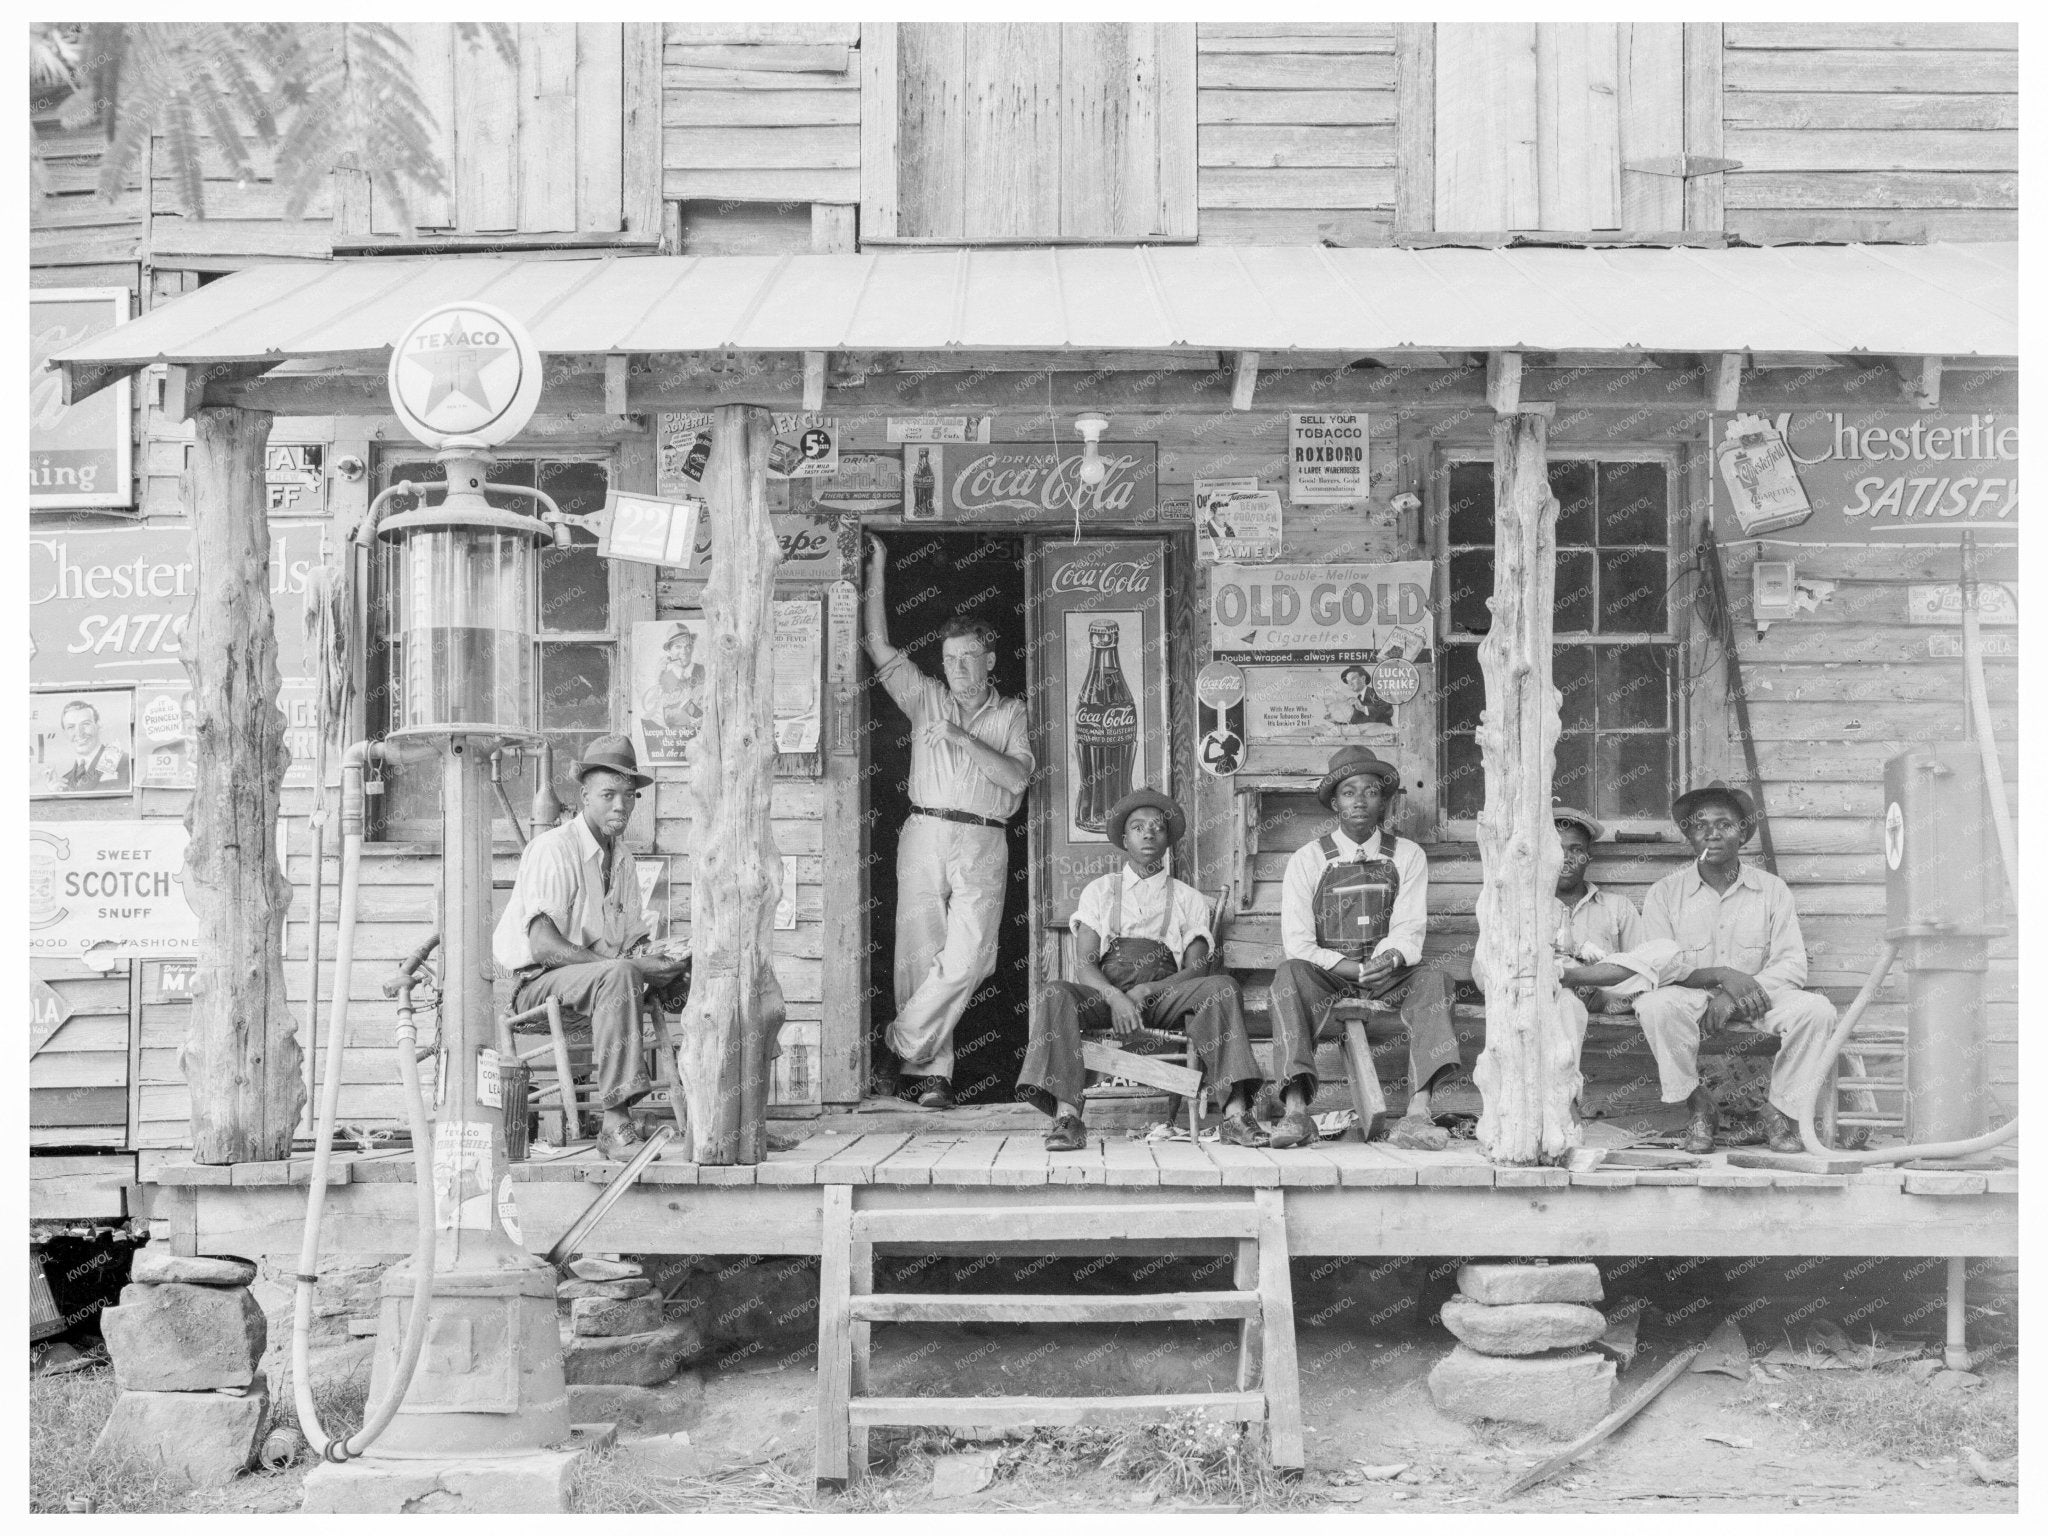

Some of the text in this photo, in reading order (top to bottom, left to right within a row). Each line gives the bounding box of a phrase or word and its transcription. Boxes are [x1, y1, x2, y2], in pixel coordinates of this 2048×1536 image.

[416, 331, 500, 350] TEXACO
[1300, 415, 1358, 424] SELL YOUR
[1296, 428, 1362, 439] TOBACCO
[1001, 455, 1056, 465] DRINK
[1295, 446, 1363, 462] ROXBORO
[1739, 442, 1786, 485] Chesterfield
[1298, 466, 1361, 475] 4 LARGE WAREHOUSES
[951, 454, 1144, 511] Coca-Cola
[1304, 485, 1357, 493] Accommodations
[618, 503, 670, 546] 22
[1051, 560, 1154, 593] Coca-Cola
[1274, 569, 1370, 582] Double-Mellow
[1216, 582, 1429, 627] OLD GOLD
[1266, 630, 1349, 647] Cigarettes
[1221, 653, 1252, 663] Double
[1303, 652, 1336, 664] always
[1379, 667, 1413, 679] LUCKY
[1198, 675, 1242, 691] Coca-Cola
[1377, 679, 1416, 691] STRIKE
[145, 714, 180, 726] PRINCELY
[1075, 705, 1136, 728] Coca-Cola
[664, 727, 677, 736] the
[678, 728, 694, 738] pipe
[662, 735, 675, 747] the
[156, 756, 172, 766] 50
[97, 850, 153, 861] SWEET
[65, 871, 170, 898] SCOTCH
[98, 908, 153, 919] SNUFF
[445, 1129, 480, 1137] TEXACO
